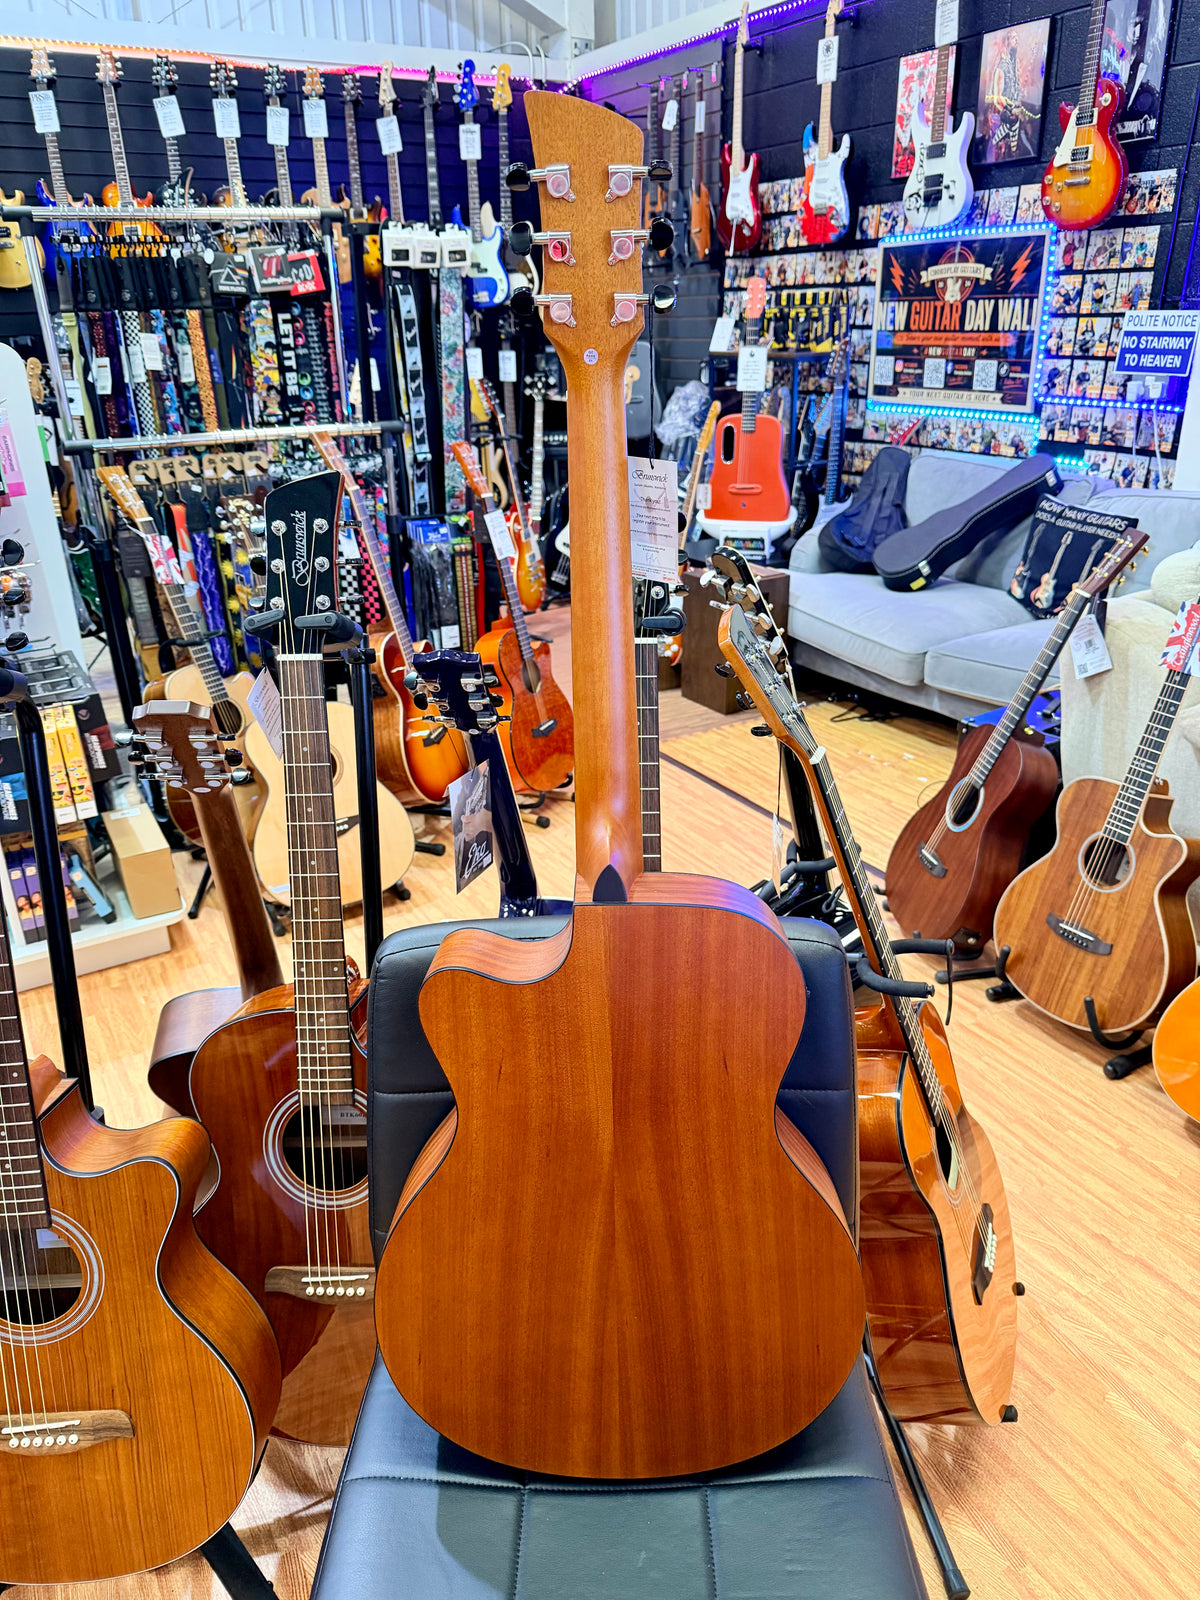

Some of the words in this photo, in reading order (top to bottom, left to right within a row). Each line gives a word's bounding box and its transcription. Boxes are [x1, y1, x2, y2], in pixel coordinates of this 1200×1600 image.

[876, 301, 909, 331] NEW
[909, 300, 962, 331] GUITAR
[963, 298, 995, 331] DAY
[1127, 314, 1160, 327] POLITE
[1161, 314, 1198, 327] NOTICE
[277, 312, 295, 348] LET
[1122, 335, 1138, 349] NO
[1139, 335, 1193, 350] STAIRWAY
[282, 349, 297, 370] IT
[1124, 353, 1138, 367] TO
[1139, 353, 1182, 368] HEAVEN
[285, 371, 299, 396] BE
[1034, 511, 1050, 521] DOES
[1055, 517, 1076, 530] GUITAR
[1074, 522, 1097, 534] PLAYER
[1039, 500, 1065, 514] HOW
[1061, 507, 1089, 522] MANY
[1086, 513, 1128, 532] GUITARS
[290, 509, 310, 587] Brunswick
[1170, 611, 1200, 668] Tanglewood
